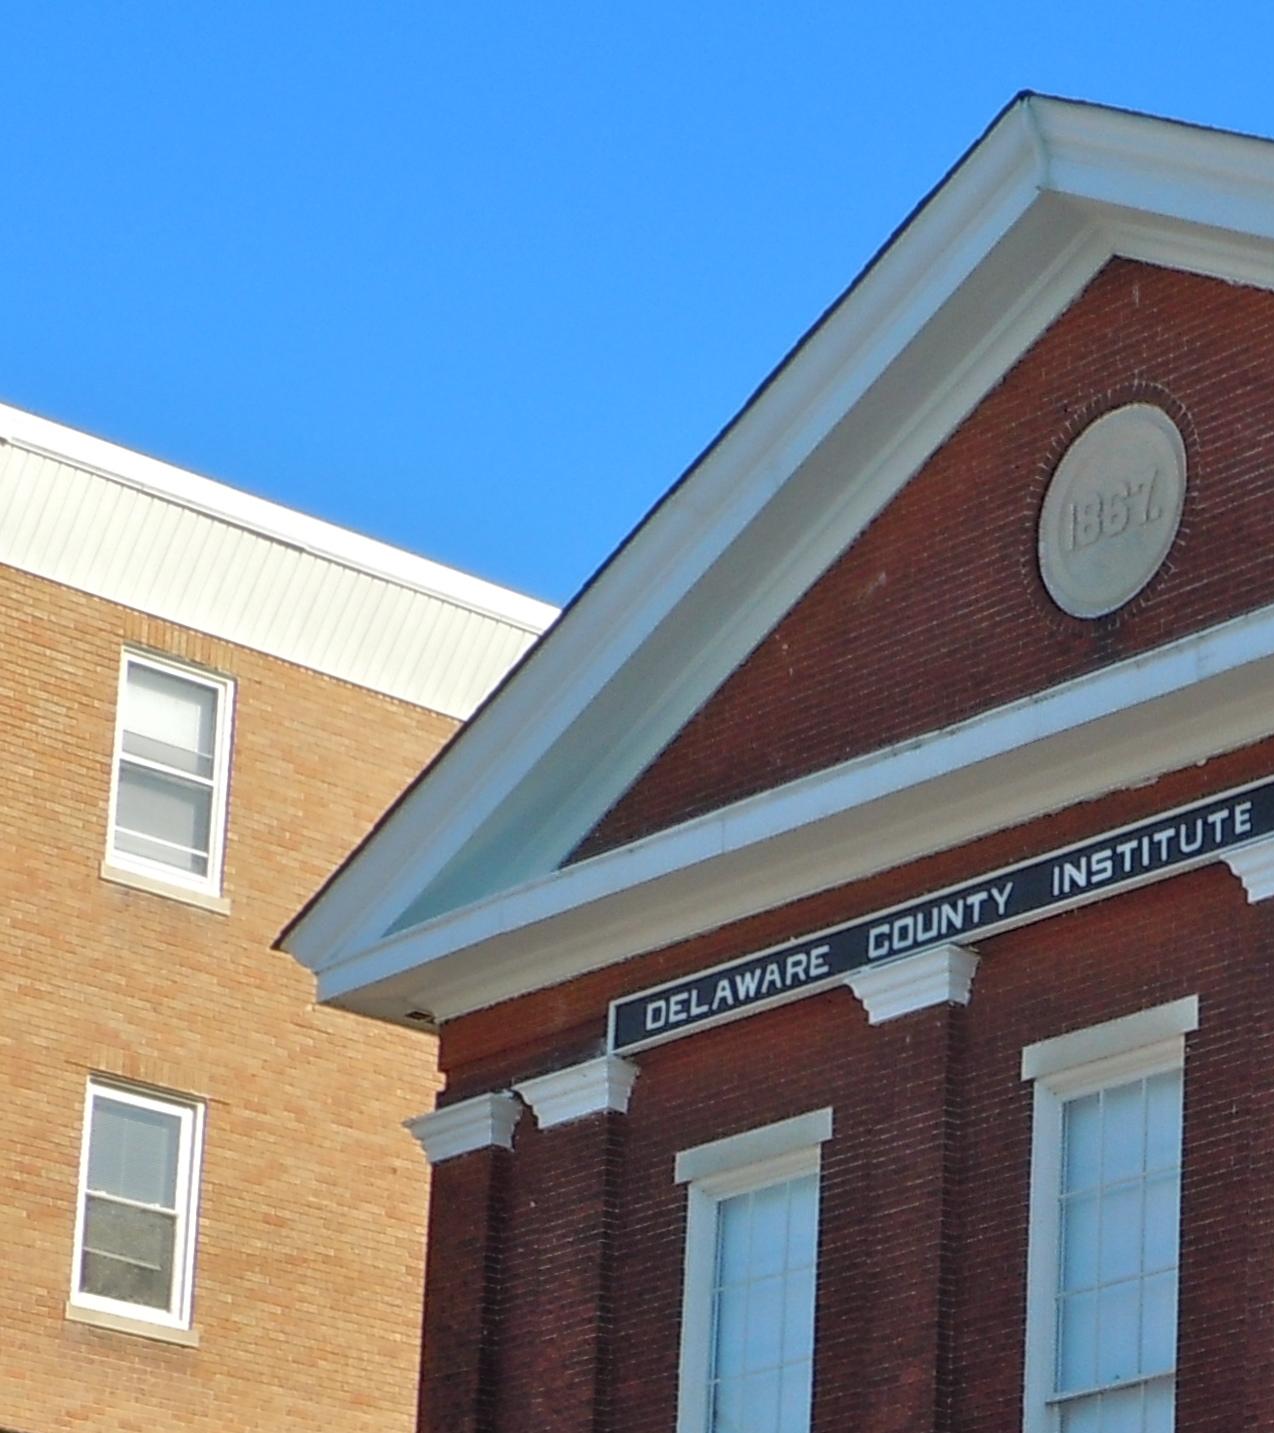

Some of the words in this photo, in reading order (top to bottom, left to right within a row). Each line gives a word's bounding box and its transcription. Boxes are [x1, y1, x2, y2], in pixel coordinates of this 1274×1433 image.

[645, 945, 830, 1031] DELAWARE
[867, 881, 1013, 959] COUNTY
[1052, 800, 1253, 897] INSTITUTE
